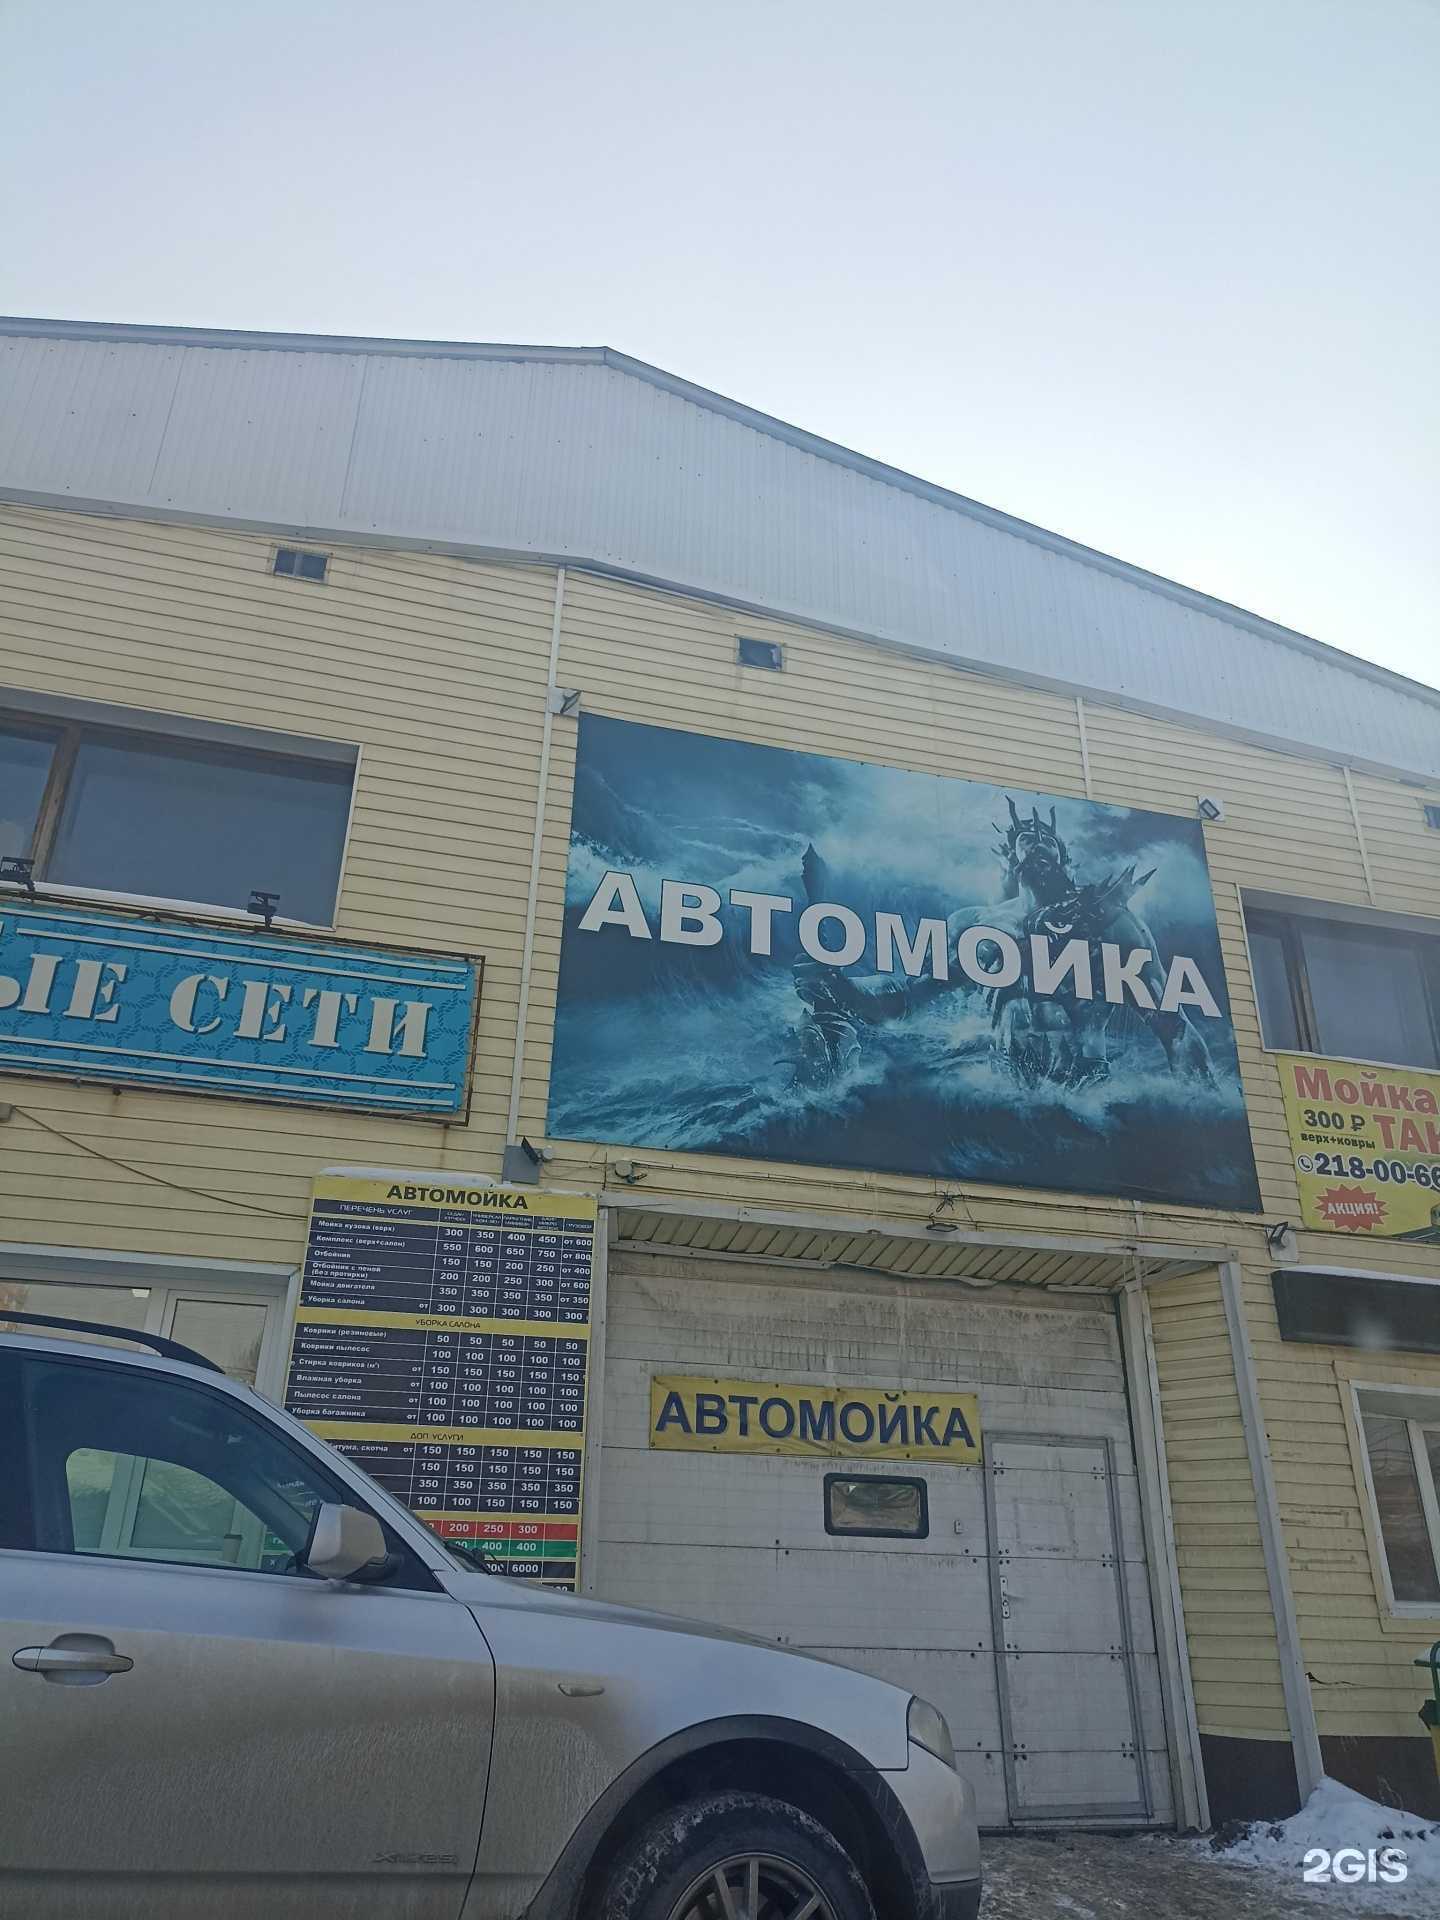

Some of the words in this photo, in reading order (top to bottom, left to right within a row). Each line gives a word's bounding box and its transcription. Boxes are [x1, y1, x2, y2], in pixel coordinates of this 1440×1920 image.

[578, 870, 1222, 1018] АВТОМОЙКА
[170, 973, 433, 1058] СЕТИ
[1294, 1065, 1439, 1115] Мойка
[1303, 1109, 1345, 1130] 300
[1301, 1132, 1375, 1149] верх+ковры
[387, 1185, 528, 1210] АВТОМОЙКА
[340, 1204, 384, 1214] ПЕРЕЧЕНЬ
[1327, 1202, 1378, 1216] АКЦИЯ!
[443, 1258, 460, 1266] 150
[437, 1304, 455, 1312] 300
[470, 1306, 487, 1314] 300
[502, 1308, 519, 1316] 300
[534, 1310, 551, 1318] 300
[565, 1312, 582, 1320] 300
[416, 1320, 448, 1328] УБОРКА
[530, 1356, 548, 1364] 100
[558, 1420, 576, 1428] 100
[655, 1391, 976, 1448] АВТОМОЙКА
[556, 1468, 574, 1476] 150
[453, 1481, 472, 1489] 350
[488, 1482, 506, 1490] 350
[452, 1498, 471, 1506] 100
[486, 1499, 505, 1507] 150
[520, 1500, 538, 1508] 150
[554, 1501, 572, 1509] 150
[449, 1524, 469, 1532] 200
[484, 1525, 503, 1533] 250
[482, 1542, 502, 1550] 400
[517, 1543, 536, 1551] 400
